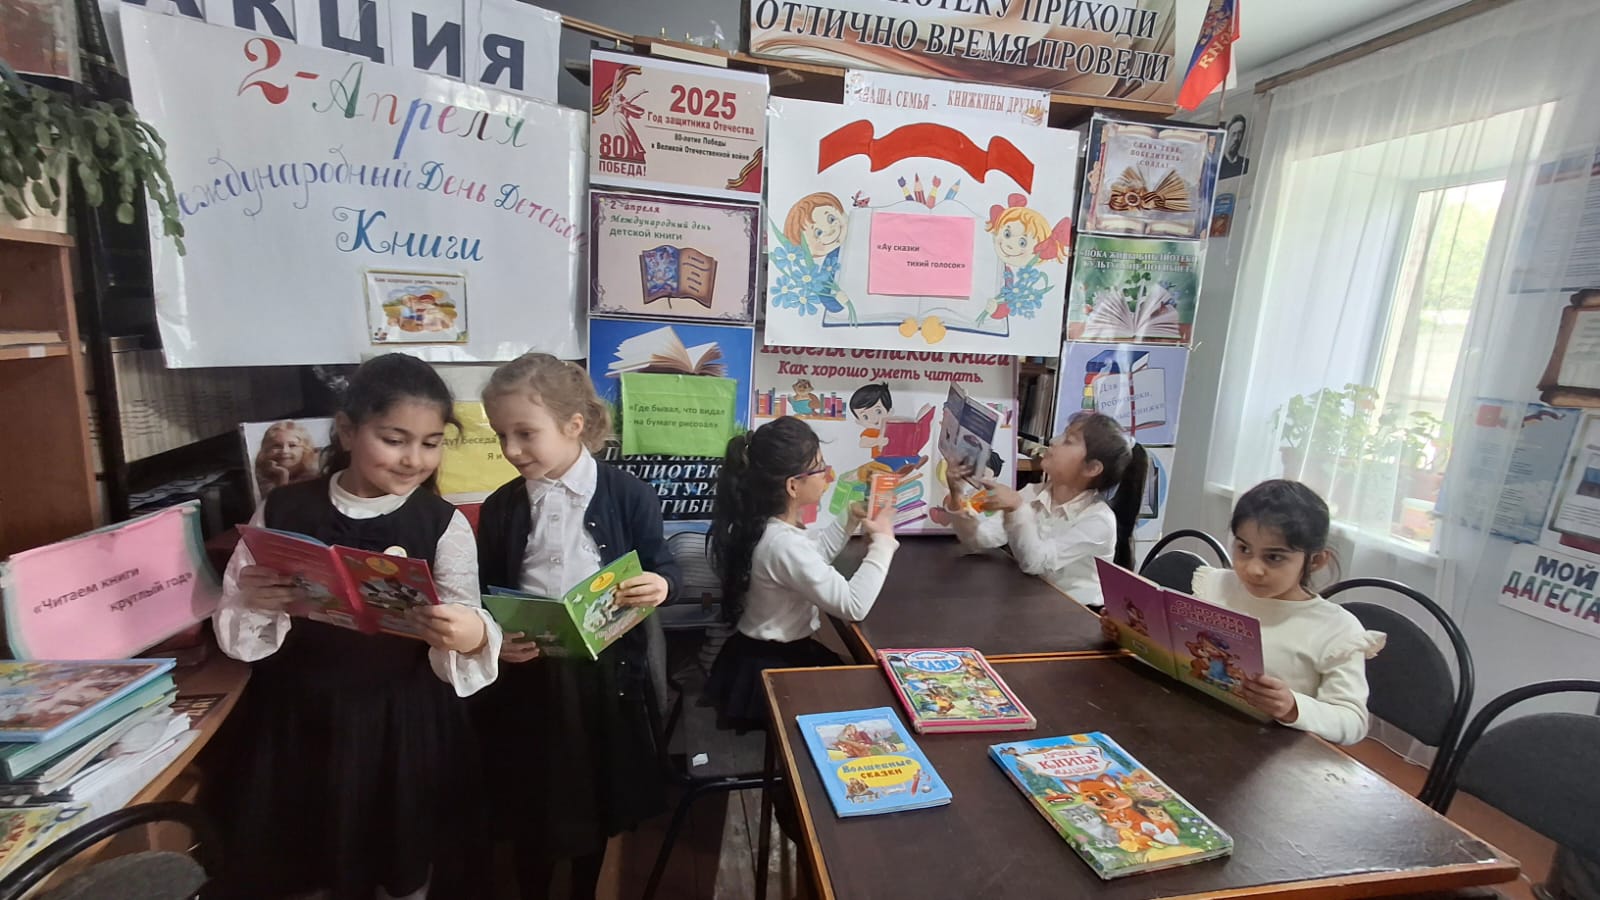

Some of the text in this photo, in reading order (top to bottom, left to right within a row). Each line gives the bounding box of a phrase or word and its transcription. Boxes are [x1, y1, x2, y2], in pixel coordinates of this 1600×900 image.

[1020, 0, 1158, 40] ПРИХОДИ
[755, 0, 918, 50] ОТЛИЧНО
[925, 23, 1030, 66] ВРЕМЯ
[1033, 38, 1171, 86] ПРОВЕДИ
[669, 84, 737, 121] 2025
[895, 90, 931, 110] СЕМЬЯ
[947, 89, 1005, 112] КНИЖКИНЫ
[647, 111, 755, 136] Год защитника Отечества
[599, 133, 626, 159] 80
[703, 136, 726, 147] Победы
[656, 142, 683, 153] Великой
[685, 145, 730, 158] Отечественной
[598, 161, 647, 177] ПОБЕДА!
[178, 144, 412, 218] еждународный
[417, 160, 488, 203] День
[610, 200, 661, 214] 2 апреля
[609, 215, 711, 231] Международный день
[333, 208, 483, 262] Книги
[654, 232, 683, 241] книги
[930, 261, 966, 269] голосок»
[948, 353, 1010, 366] книги
[777, 360, 984, 383] Как хорошо уметь читать.
[646, 418, 677, 427] бумаге
[618, 464, 723, 480] БЛИОТЕК
[651, 482, 719, 497] ЬТУРА
[660, 499, 714, 514] ГИБН
[1534, 555, 1599, 591] МОЙ
[33, 567, 140, 615] «Читаем книги
[109, 571, 193, 613] круглый год»
[1501, 570, 1600, 625] ДАГЕСТА
[1038, 755, 1098, 769] КНИГА
[860, 768, 903, 779] СКАЗКИ
